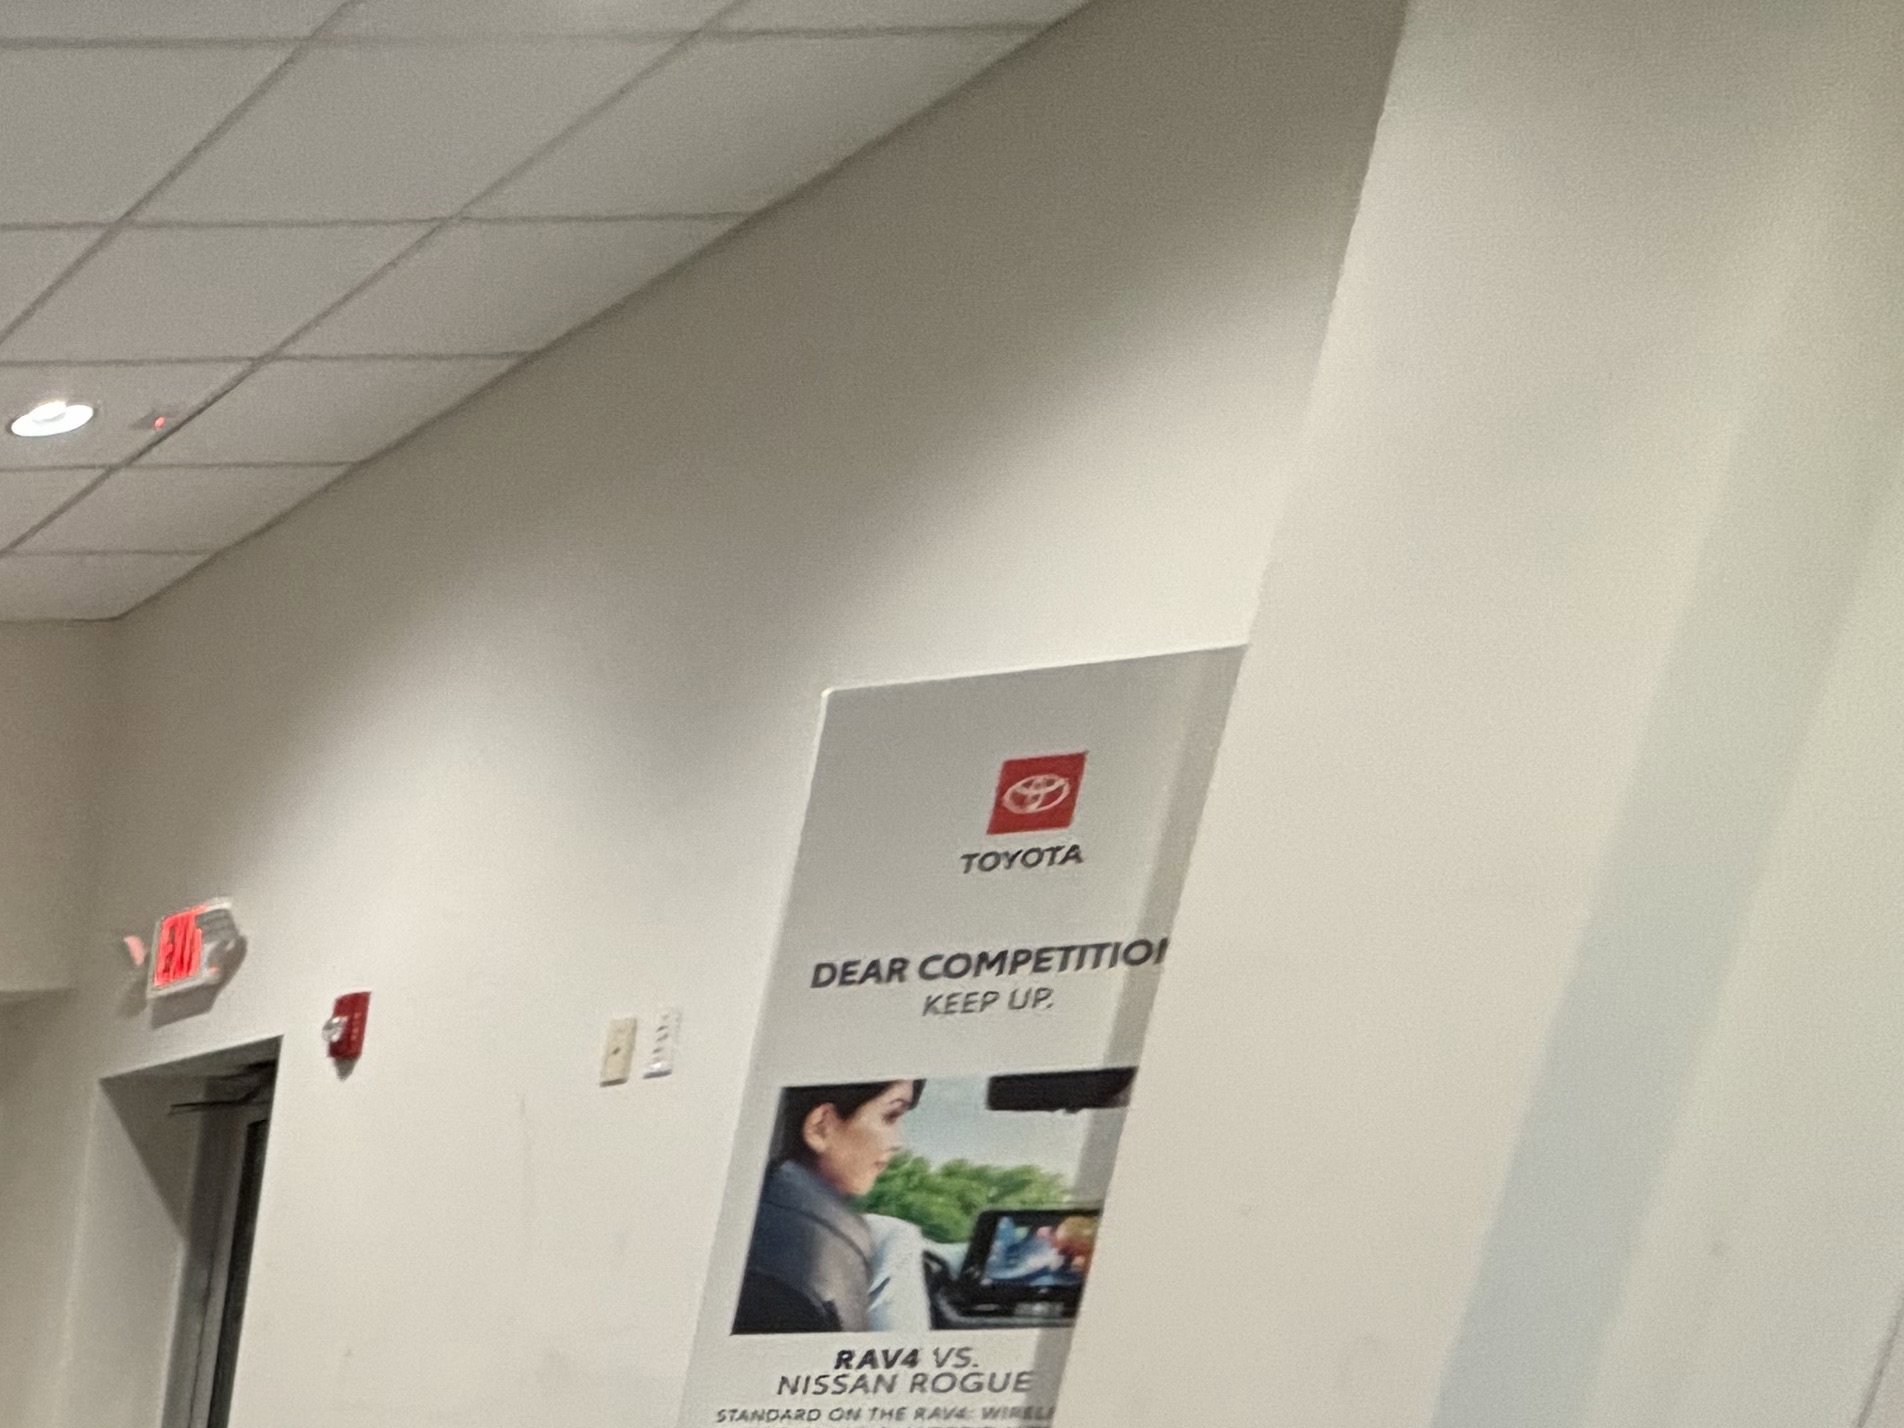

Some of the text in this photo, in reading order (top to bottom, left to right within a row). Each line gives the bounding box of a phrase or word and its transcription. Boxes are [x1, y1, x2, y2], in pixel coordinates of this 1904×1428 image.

[959, 843, 1085, 875] TOYOTA
[810, 955, 909, 990] DEAR
[922, 986, 1054, 1018] KEEP UP.
[833, 1346, 979, 1371] RAV4 VS.
[776, 1370, 1036, 1396] NISSAN ROGUE
[716, 1407, 822, 1424] STANDARD
[828, 1406, 863, 1422] ON
[868, 1406, 907, 1422] THE
